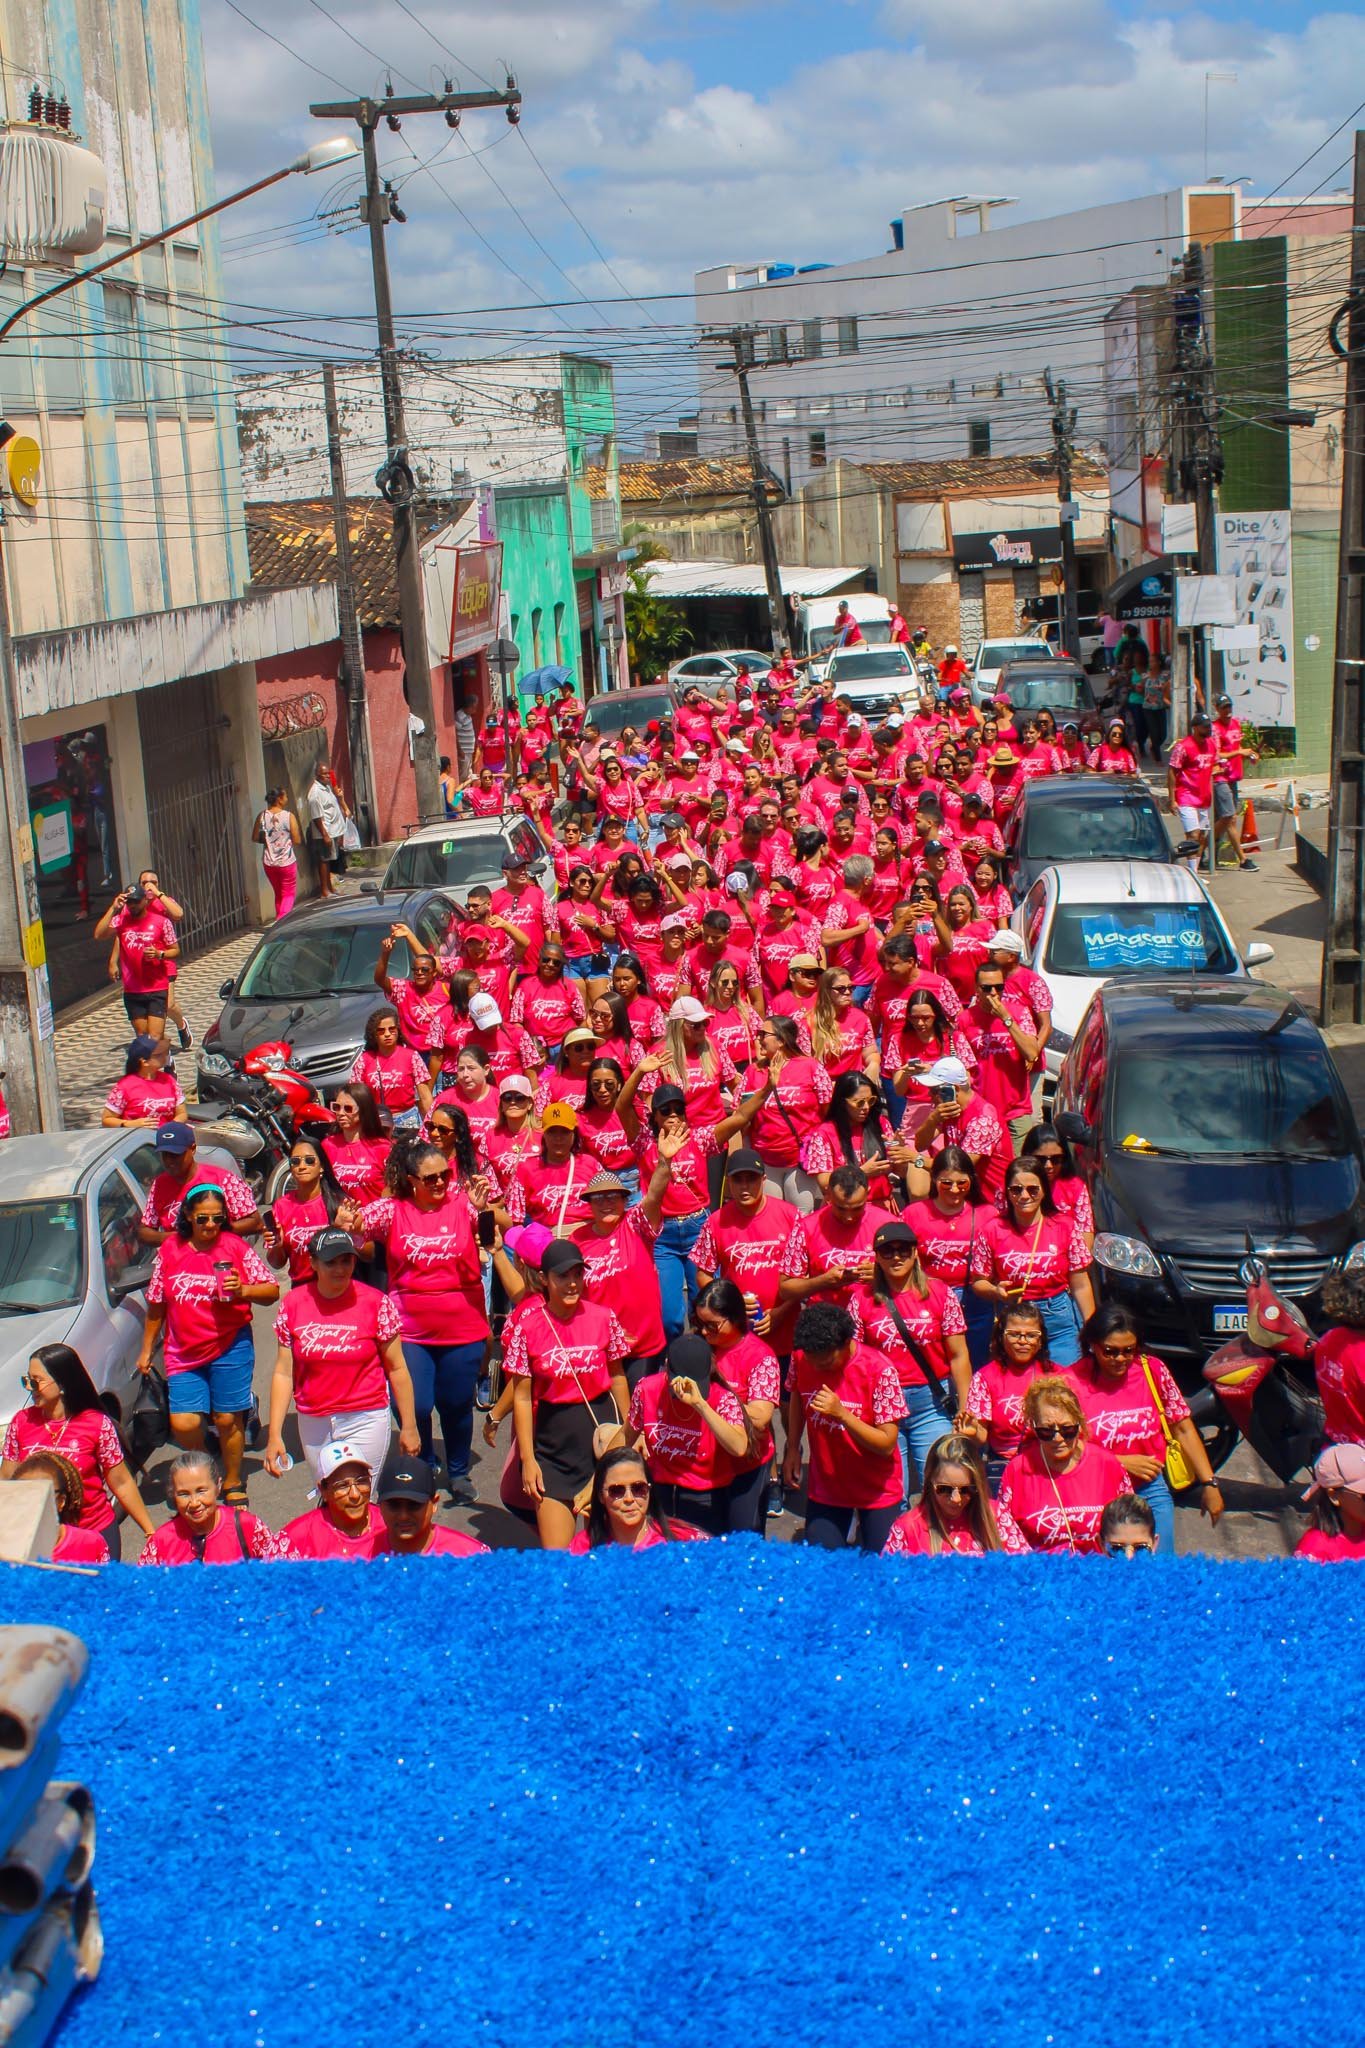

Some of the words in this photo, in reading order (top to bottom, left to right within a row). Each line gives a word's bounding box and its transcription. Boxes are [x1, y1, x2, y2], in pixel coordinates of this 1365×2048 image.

[1223, 519, 1260, 534] Dite
[1133, 606, 1172, 617] 99984-
[1083, 932, 1177, 946] Maracar
[735, 1258, 780, 1275] Ampar
[1223, 1315, 1248, 1329] IAG
